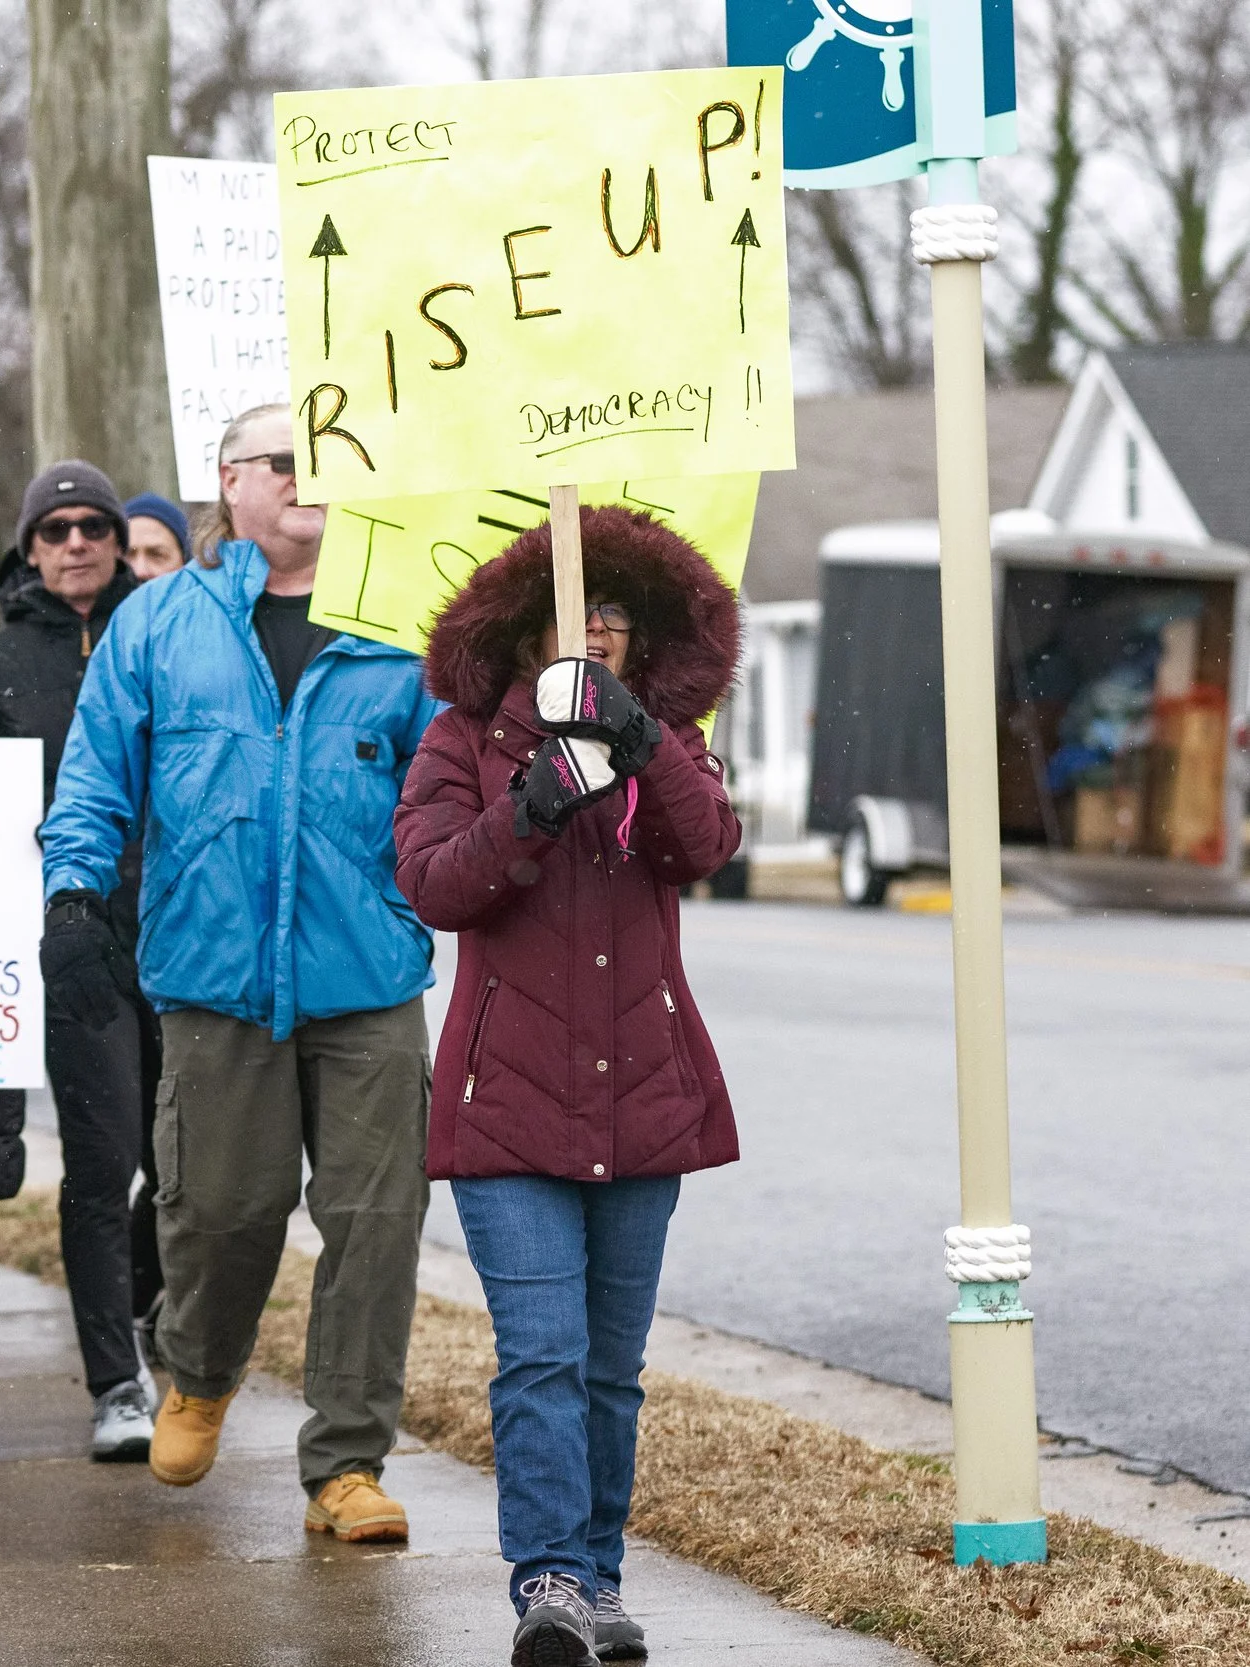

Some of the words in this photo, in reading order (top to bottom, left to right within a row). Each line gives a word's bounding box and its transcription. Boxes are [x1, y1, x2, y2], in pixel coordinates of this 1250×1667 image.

[283, 115, 457, 165] PROTECT
[219, 171, 267, 201] NOT
[193, 224, 208, 257] A
[223, 227, 280, 262] PAID
[297, 226, 562, 478] RISE
[600, 77, 767, 260] UP!
[210, 333, 217, 368] I
[235, 336, 290, 371] HATE
[519, 383, 712, 443] DEMOCRACY
